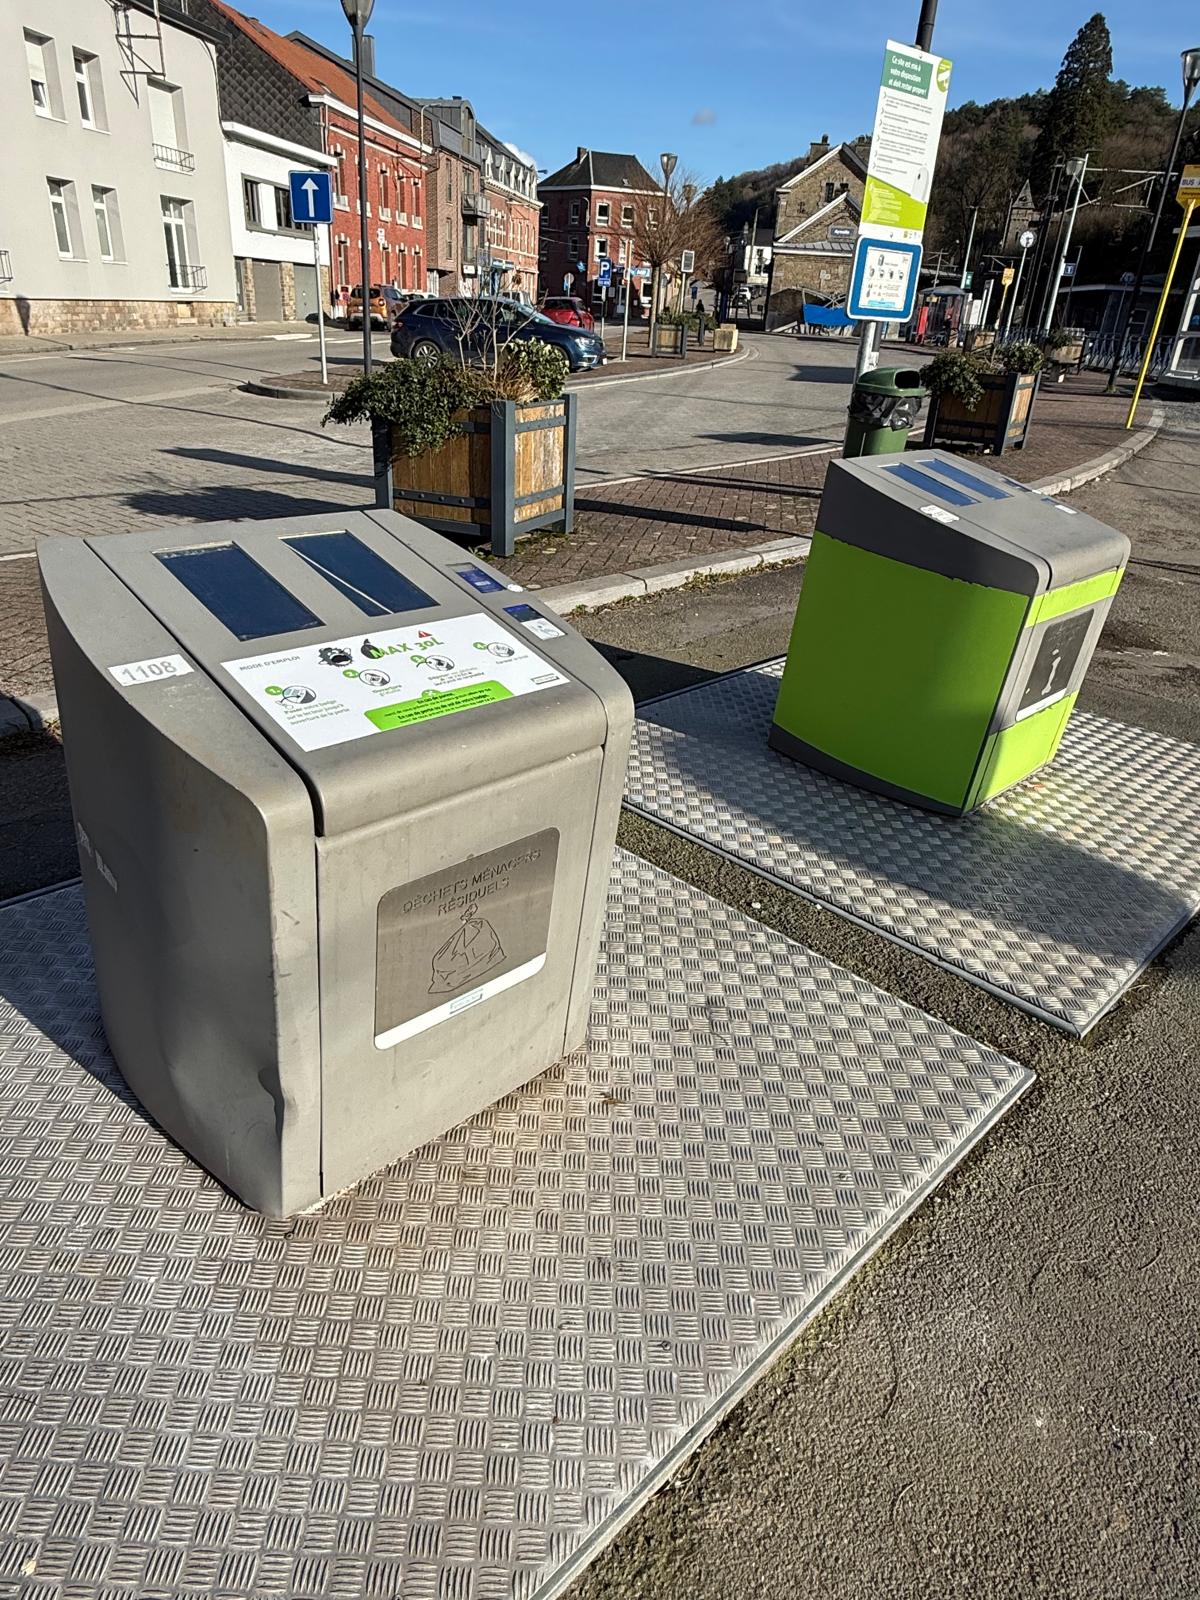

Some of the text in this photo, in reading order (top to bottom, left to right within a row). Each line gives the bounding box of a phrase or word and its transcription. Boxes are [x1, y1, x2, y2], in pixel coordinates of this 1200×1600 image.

[901, 70, 921, 82] disposition
[600, 262, 610, 276] P
[369, 637, 445, 657] MAX 30L
[121, 660, 177, 682] 1108
[264, 656, 300, 666] D'EMPLOI
[403, 849, 541, 915] DÉCHETS MÉNAGERS
[437, 877, 510, 917] RÉSIDUELS
